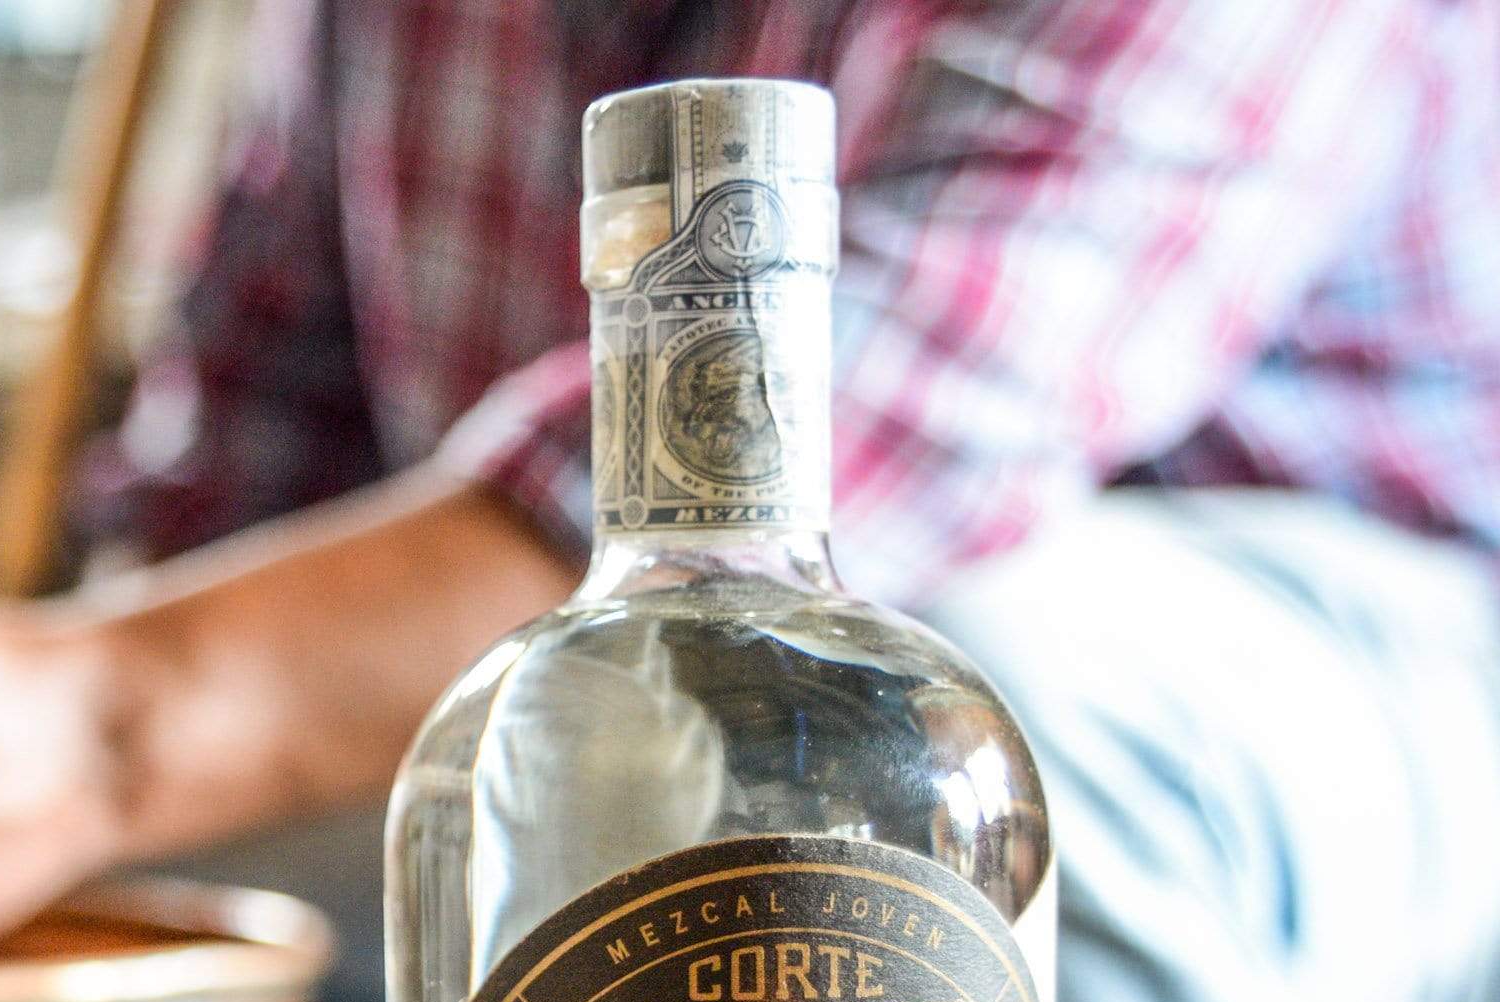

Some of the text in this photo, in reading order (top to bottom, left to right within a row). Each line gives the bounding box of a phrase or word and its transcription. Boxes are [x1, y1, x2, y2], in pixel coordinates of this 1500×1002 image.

[604, 890, 945, 966] MEZCAL JOVEN
[687, 941, 885, 1002] CORTE
